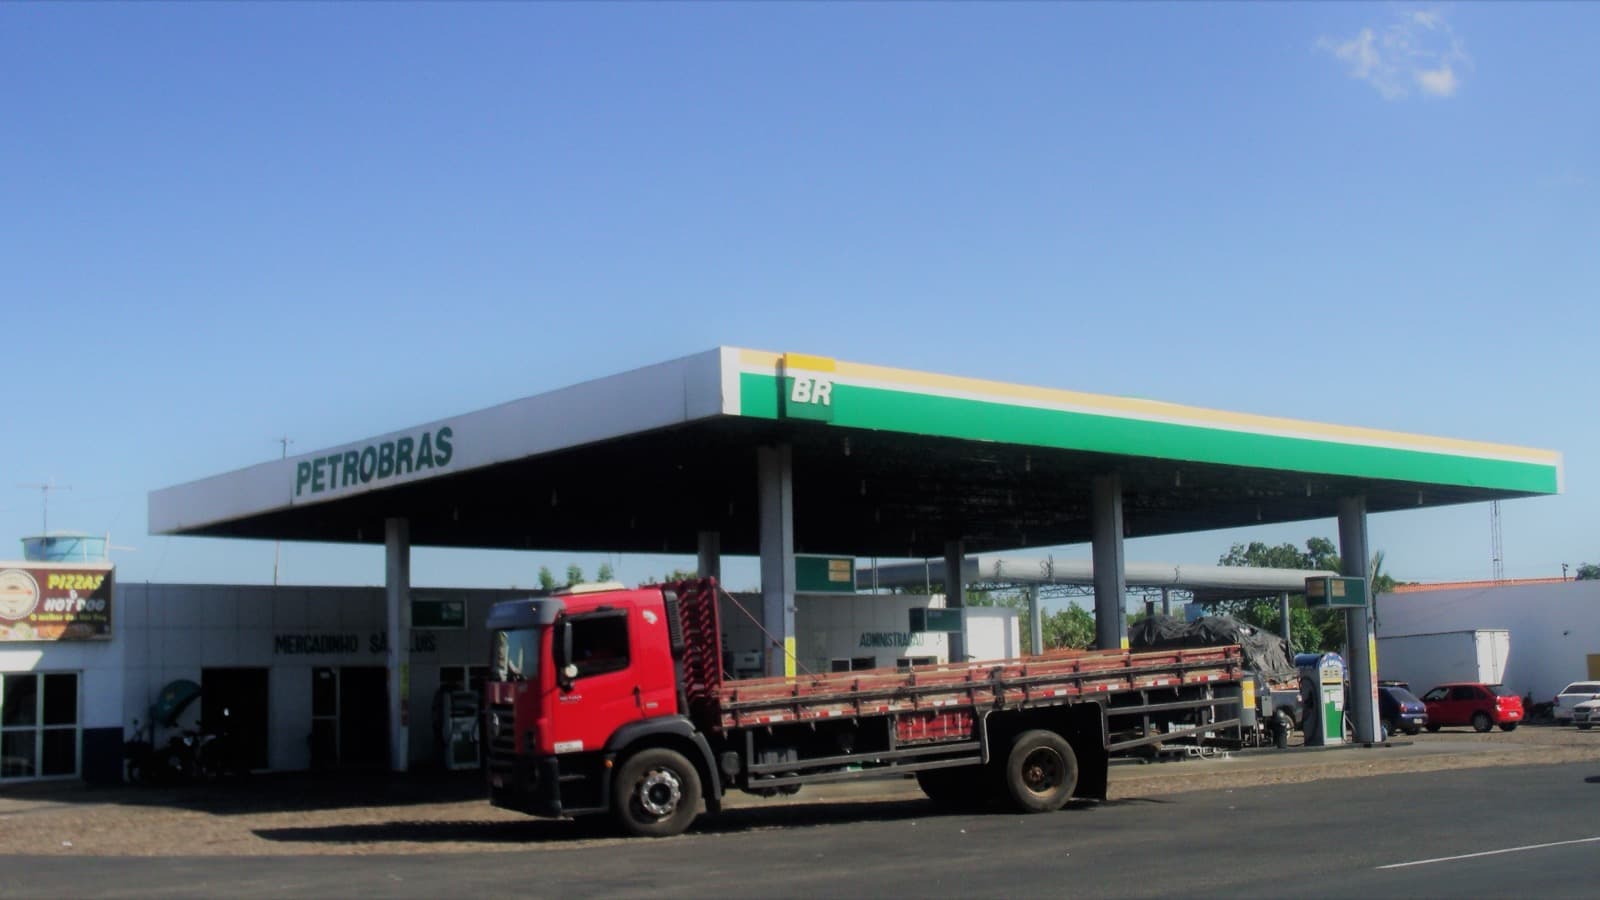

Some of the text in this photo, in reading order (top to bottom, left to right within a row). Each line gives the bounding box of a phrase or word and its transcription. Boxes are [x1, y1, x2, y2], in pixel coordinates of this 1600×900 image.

[791, 376, 833, 406] BR
[296, 426, 454, 497] PETROBRAS
[47, 573, 105, 590] PIZZAS
[44, 598, 106, 612] HOT DOG
[274, 634, 359, 655] MERCADINHO
